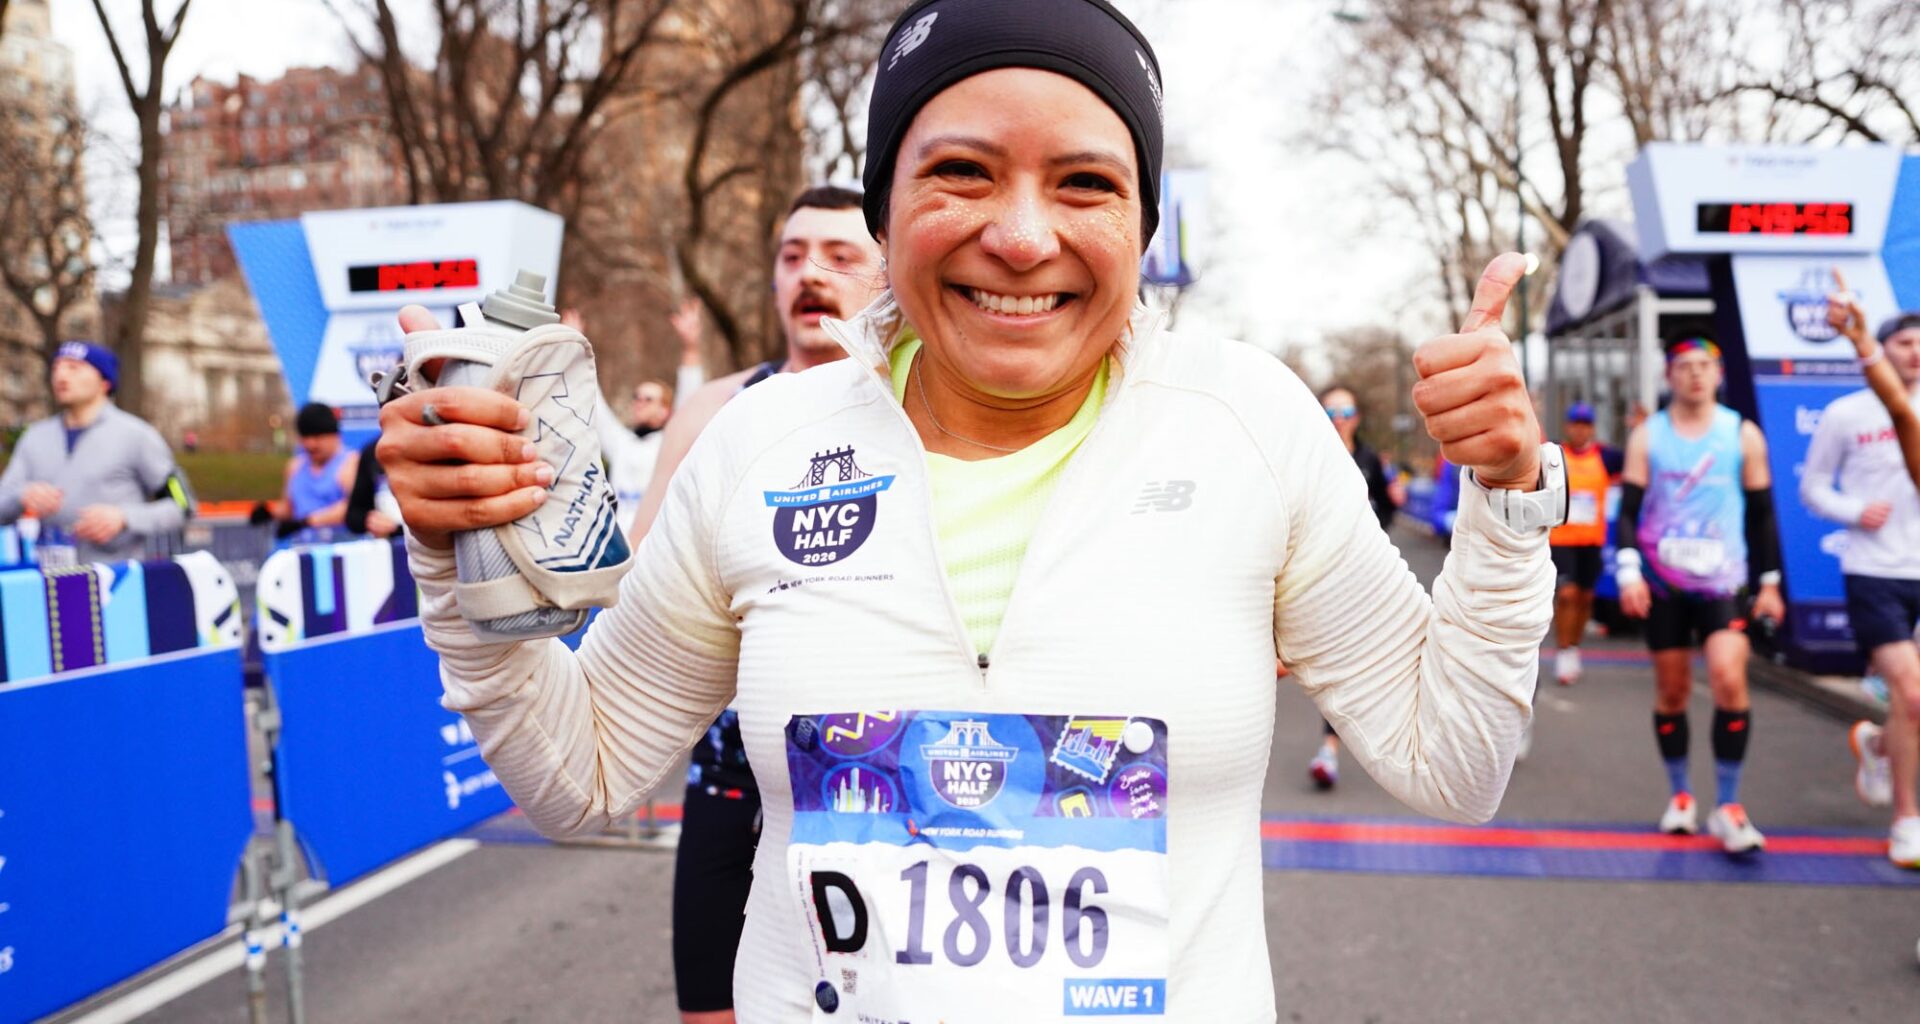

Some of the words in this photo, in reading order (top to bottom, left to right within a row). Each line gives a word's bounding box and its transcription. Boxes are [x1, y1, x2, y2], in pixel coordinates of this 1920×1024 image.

[773, 493, 817, 503] UNITED
[832, 481, 883, 496] AIRLINES
[553, 462, 599, 547] NATHAN
[792, 503, 860, 532] NYC
[794, 529, 853, 550] HALF
[803, 551, 837, 564] 2026
[805, 576, 825, 584] YORK
[943, 761, 993, 781] NYC
[947, 781, 988, 795] HALF
[811, 871, 869, 953] D
[895, 860, 1110, 969] 1806
[1069, 985, 1138, 1008] WAVE
[1142, 985, 1153, 1008] 1
